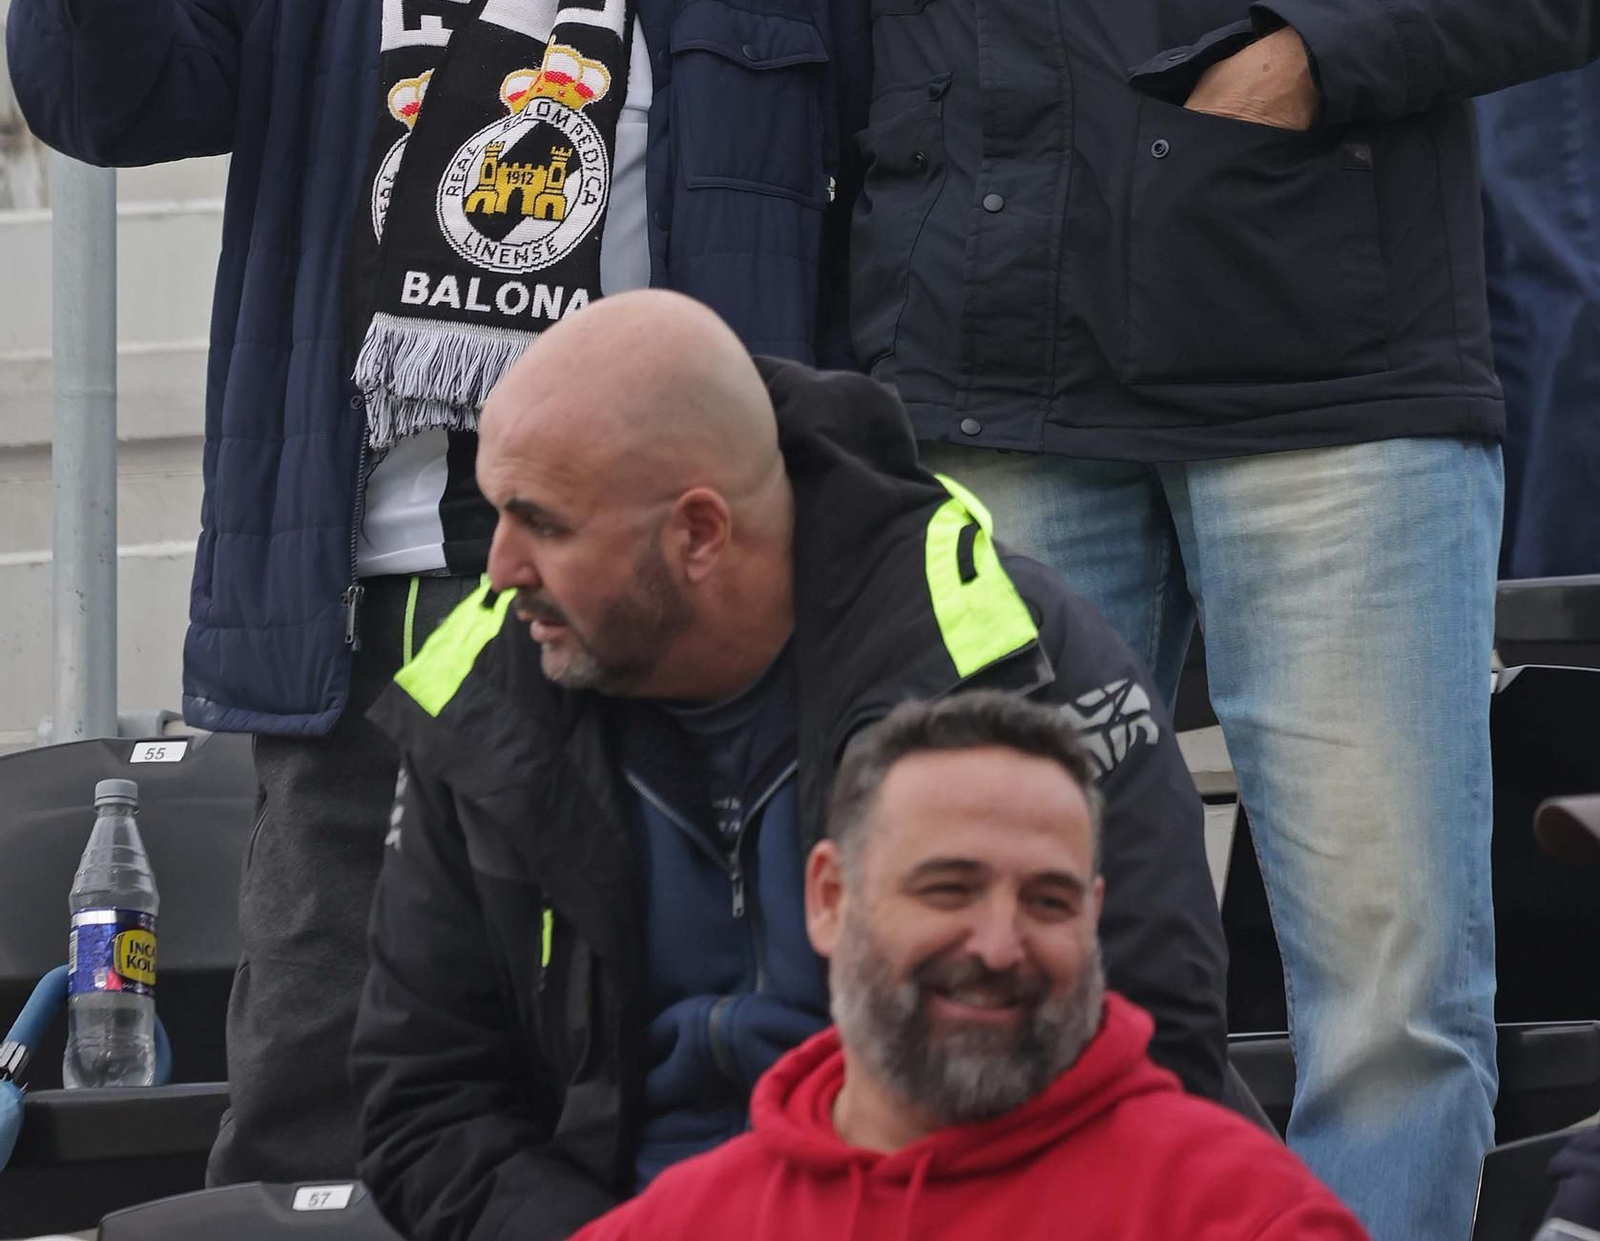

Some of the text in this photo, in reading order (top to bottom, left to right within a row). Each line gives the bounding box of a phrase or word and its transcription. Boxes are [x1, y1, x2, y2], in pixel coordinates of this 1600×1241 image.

[446, 144, 480, 197] REAL
[506, 172, 534, 186] 1912
[463, 231, 557, 265] LINENSE
[400, 270, 590, 321] BALONA
[144, 747, 167, 760] 55
[129, 940, 156, 958] INC
[126, 955, 156, 974] KOL
